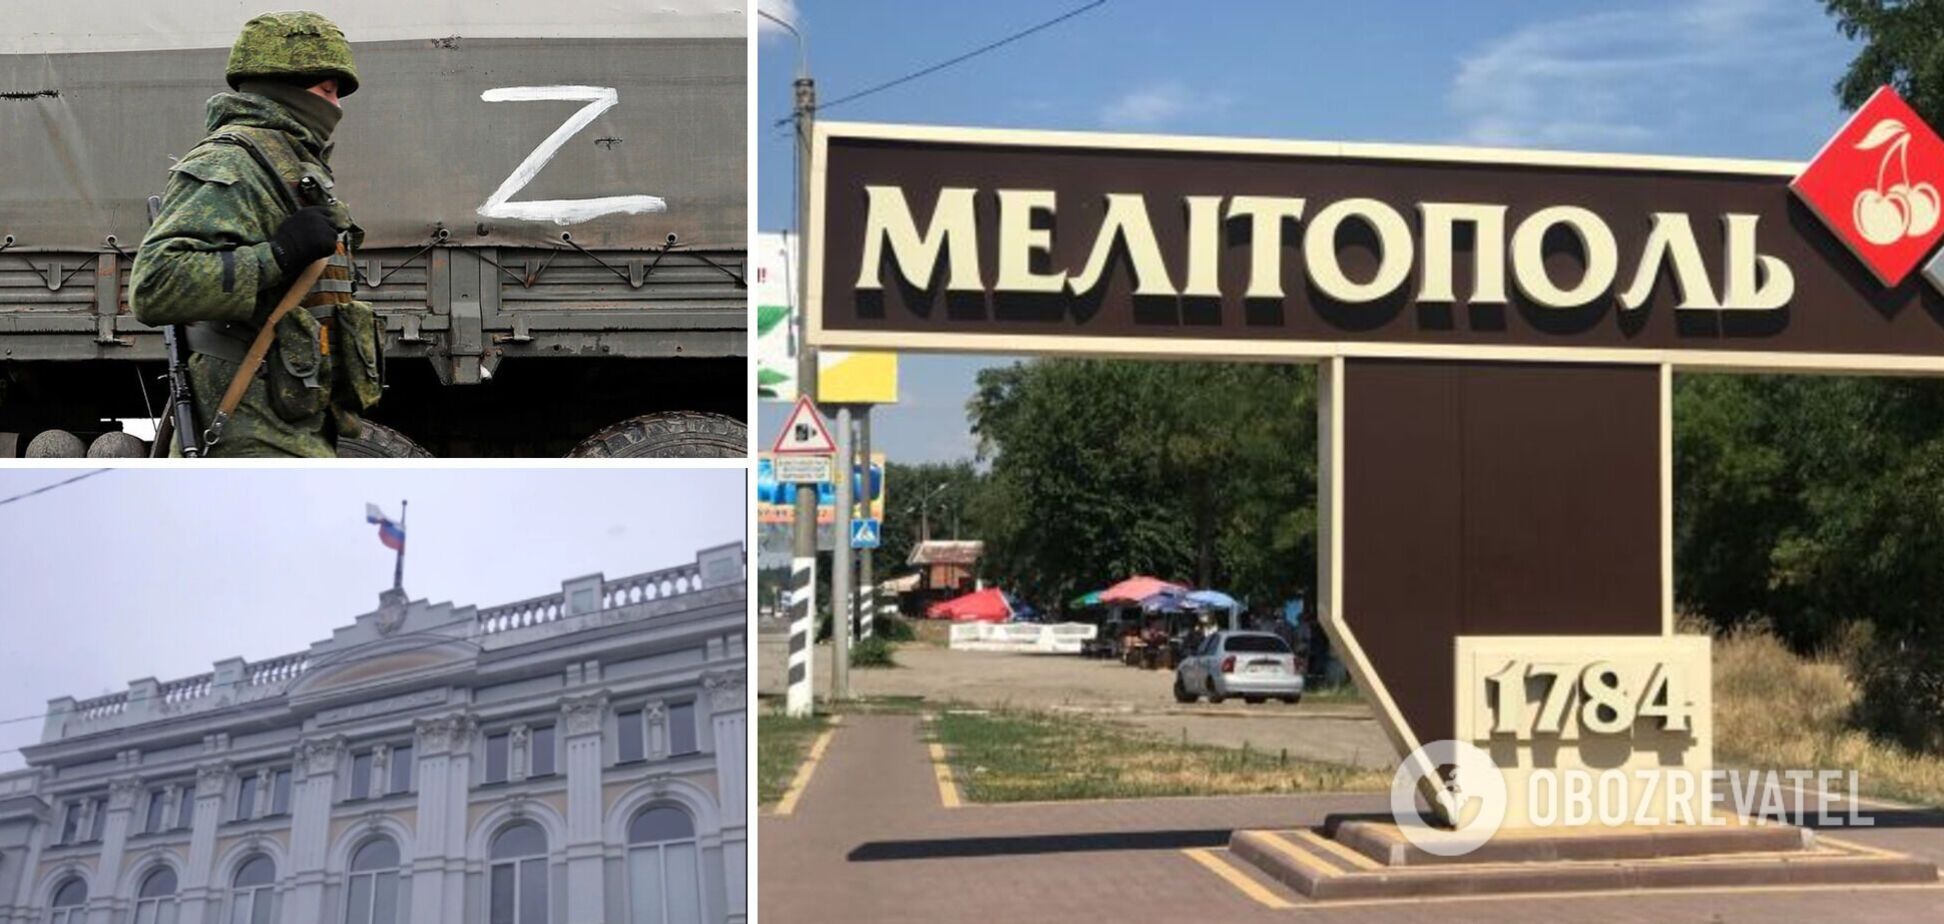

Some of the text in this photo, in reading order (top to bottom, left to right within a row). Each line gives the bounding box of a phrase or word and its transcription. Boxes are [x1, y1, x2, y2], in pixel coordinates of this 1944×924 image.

[476, 85, 667, 225] Z
[855, 185, 1795, 311] МЕЛІТОПОЛЬ
[1485, 659, 1694, 734] 1784
